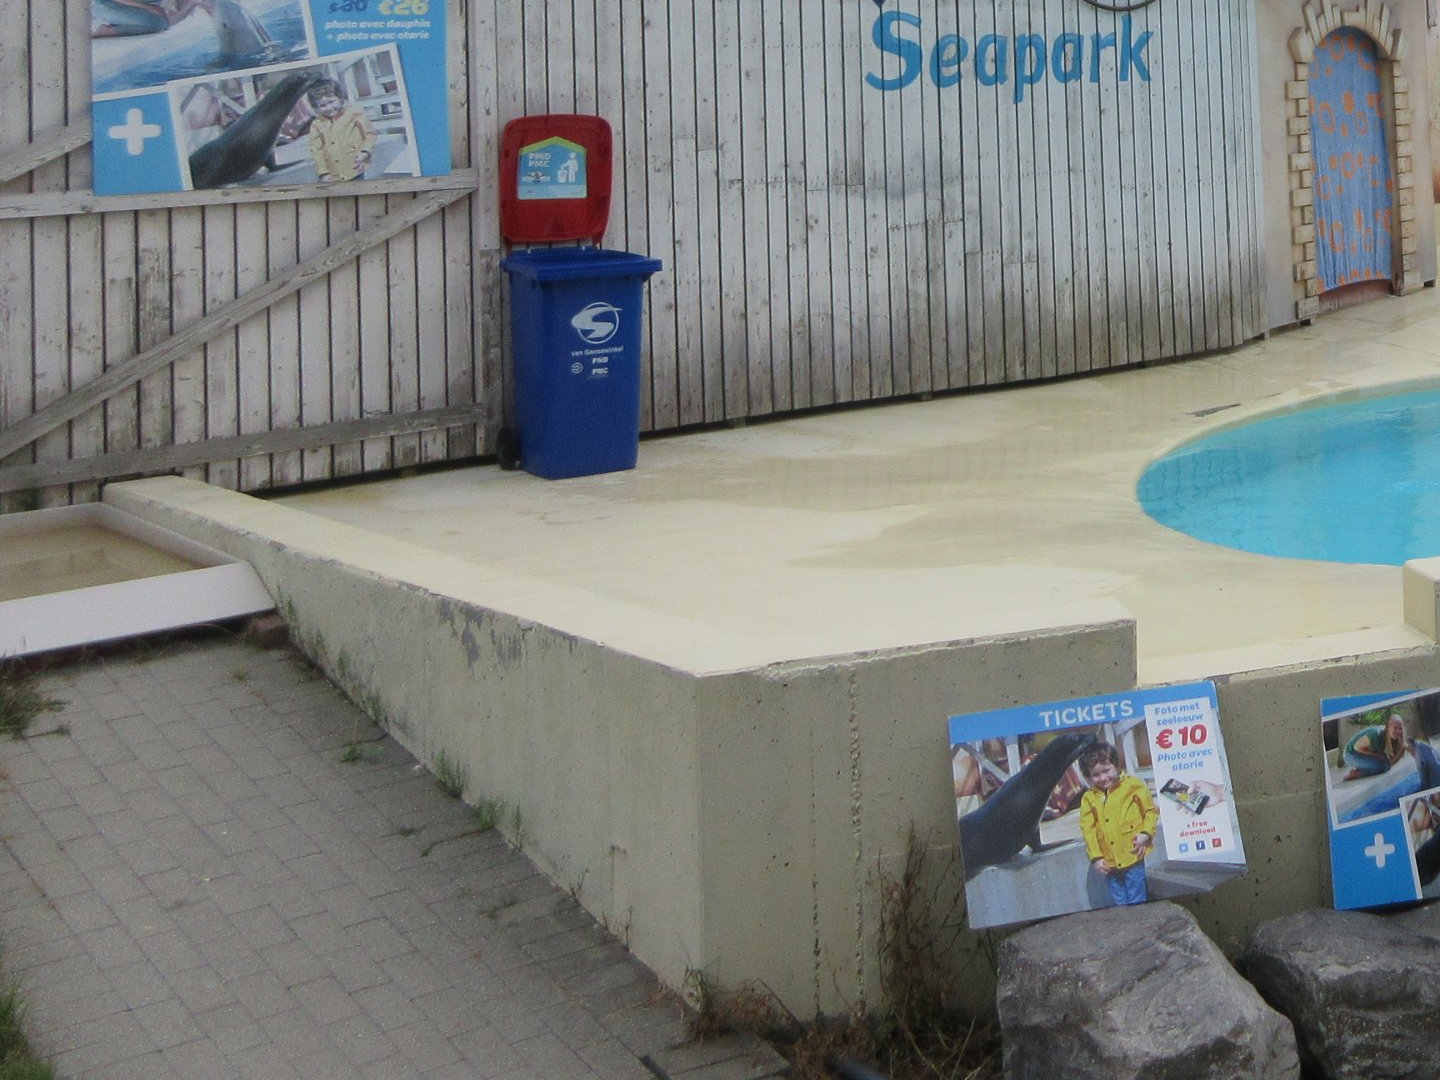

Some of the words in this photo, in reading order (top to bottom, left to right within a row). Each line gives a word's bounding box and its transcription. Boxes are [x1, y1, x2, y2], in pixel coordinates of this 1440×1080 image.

[325, 20, 358, 30] photo
[336, 32, 369, 42] photo
[865, 10, 1154, 105] Seapark
[528, 152, 551, 160] PMD
[1039, 700, 1134, 728] TICKETS
[1154, 706, 1178, 716] Foto
[1180, 702, 1200, 712] met
[1156, 713, 1204, 726] zeeleeuw
[1156, 729, 1173, 749] €
[1178, 724, 1208, 746] 10
[1157, 751, 1188, 763] Photo
[1189, 748, 1213, 758] avec
[1172, 761, 1204, 771] otarie
[1191, 820, 1208, 828] free
[1179, 827, 1216, 838] download
